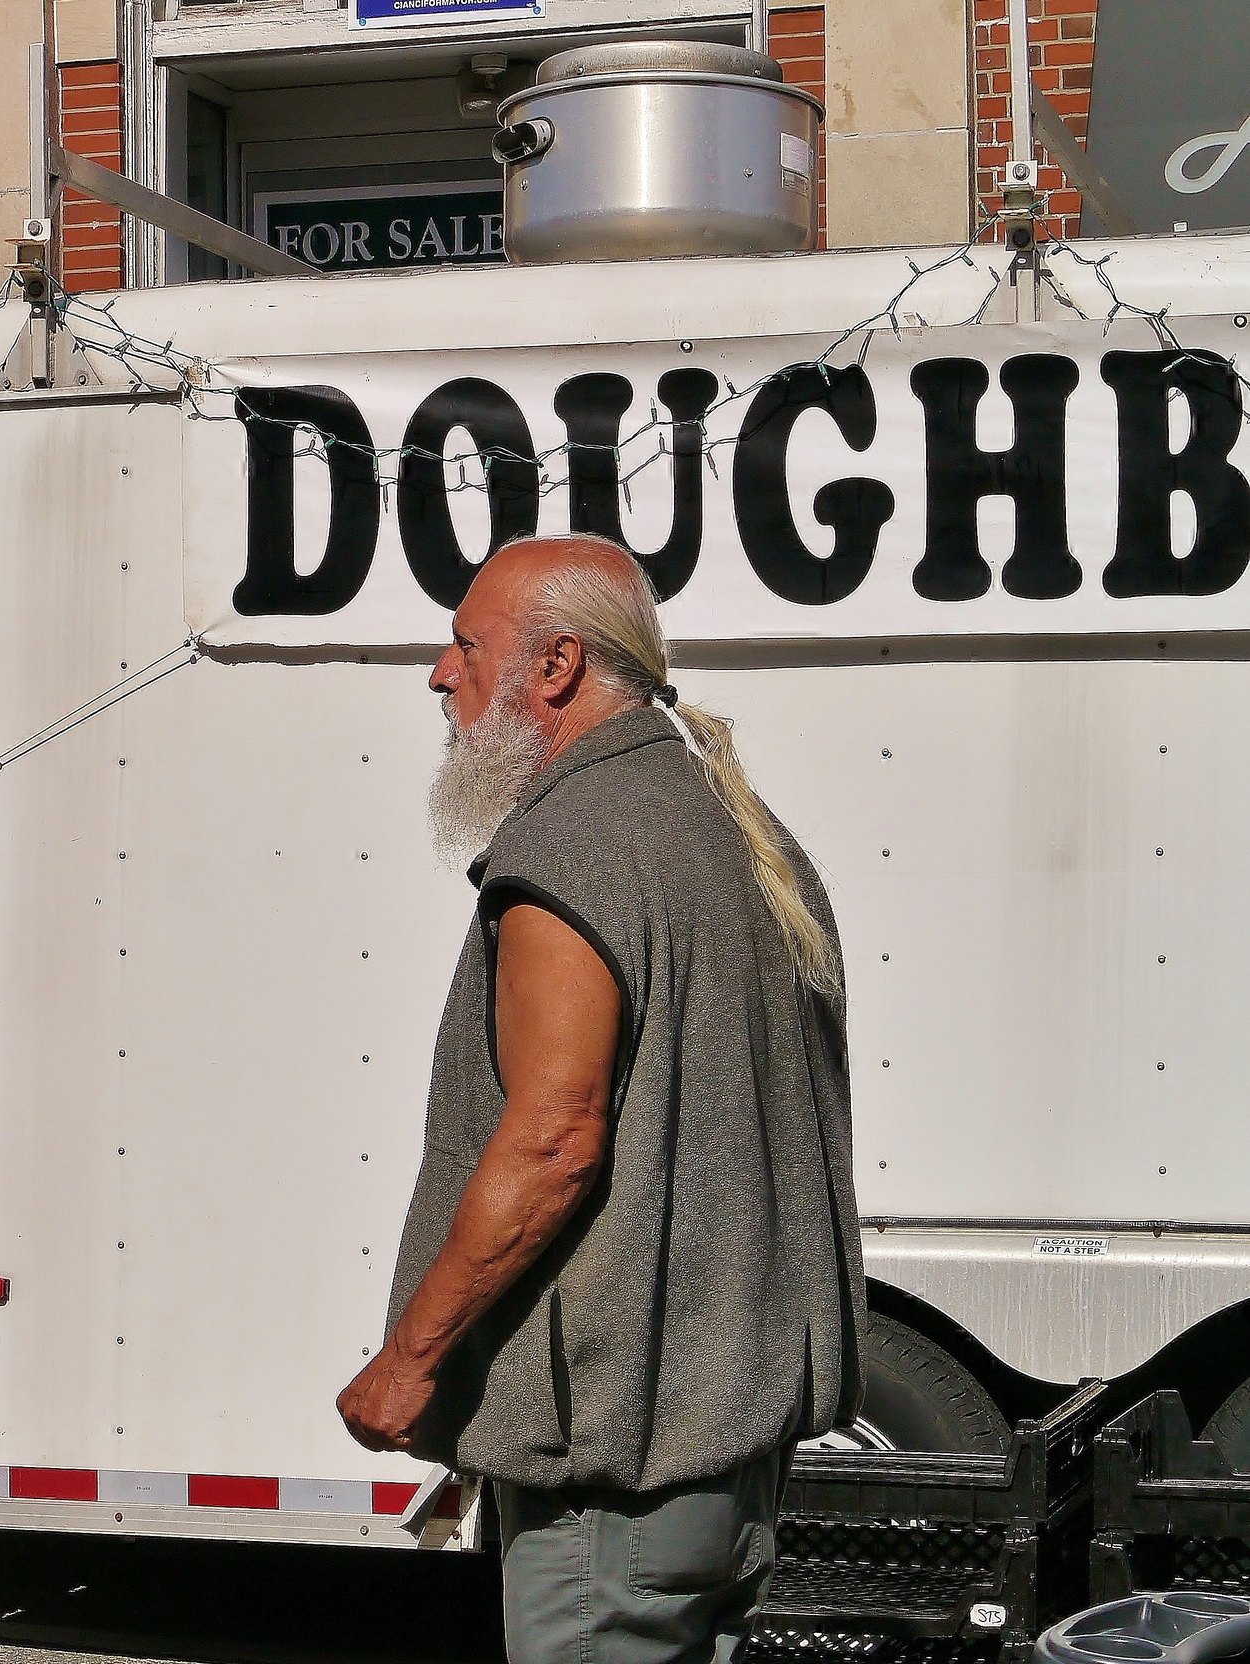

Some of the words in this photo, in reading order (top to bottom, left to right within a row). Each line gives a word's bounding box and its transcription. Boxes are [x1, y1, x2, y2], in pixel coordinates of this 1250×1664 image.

[275, 221, 375, 265] FOR
[388, 213, 506, 260] SALE
[232, 349, 1250, 617] DOUGHB
[1074, 1247, 1101, 1255] STEP
